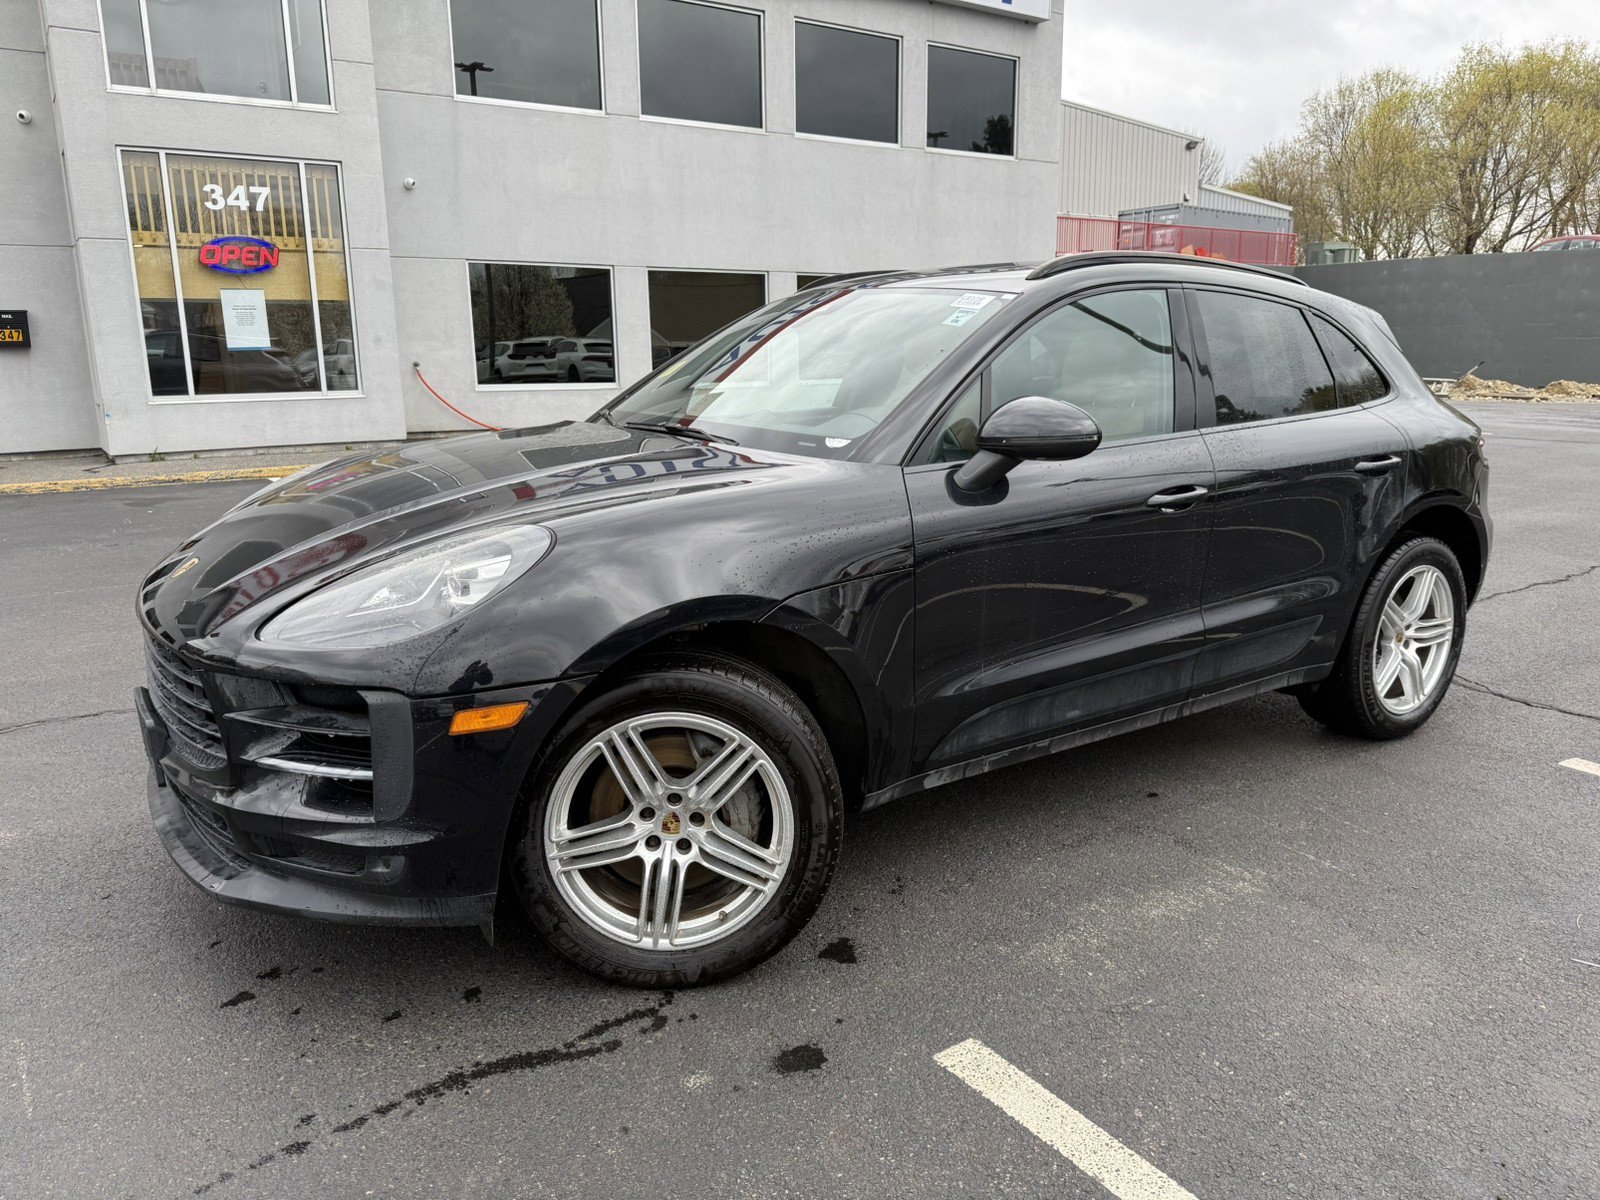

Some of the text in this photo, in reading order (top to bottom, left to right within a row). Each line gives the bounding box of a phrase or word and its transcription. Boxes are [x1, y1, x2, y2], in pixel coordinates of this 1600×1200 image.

[203, 184, 270, 211] 347
[200, 245, 279, 266] OPEN
[0, 330, 20, 341] 347
